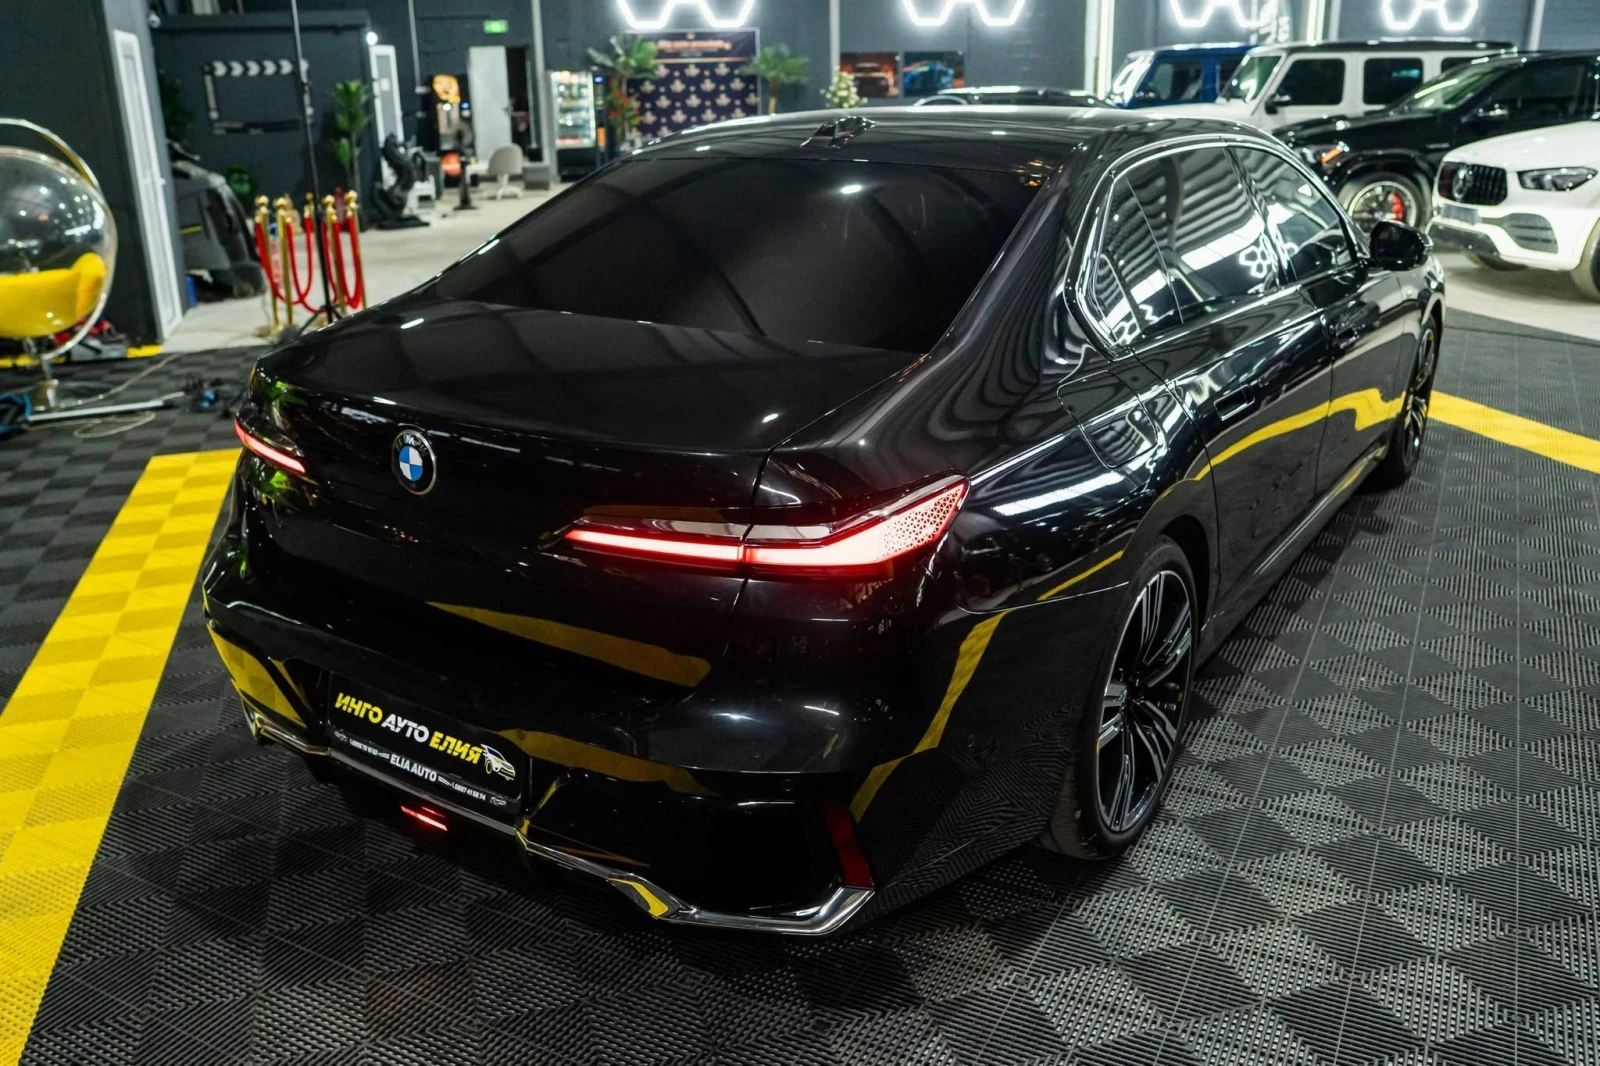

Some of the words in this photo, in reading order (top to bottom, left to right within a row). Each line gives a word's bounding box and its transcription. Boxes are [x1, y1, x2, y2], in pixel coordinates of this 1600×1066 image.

[335, 692, 383, 724] ИНГО
[381, 713, 430, 743] АУТО
[429, 731, 483, 765] ЕЛИЯ
[390, 753, 411, 772] ELIA
[410, 762, 438, 782] AUTO
